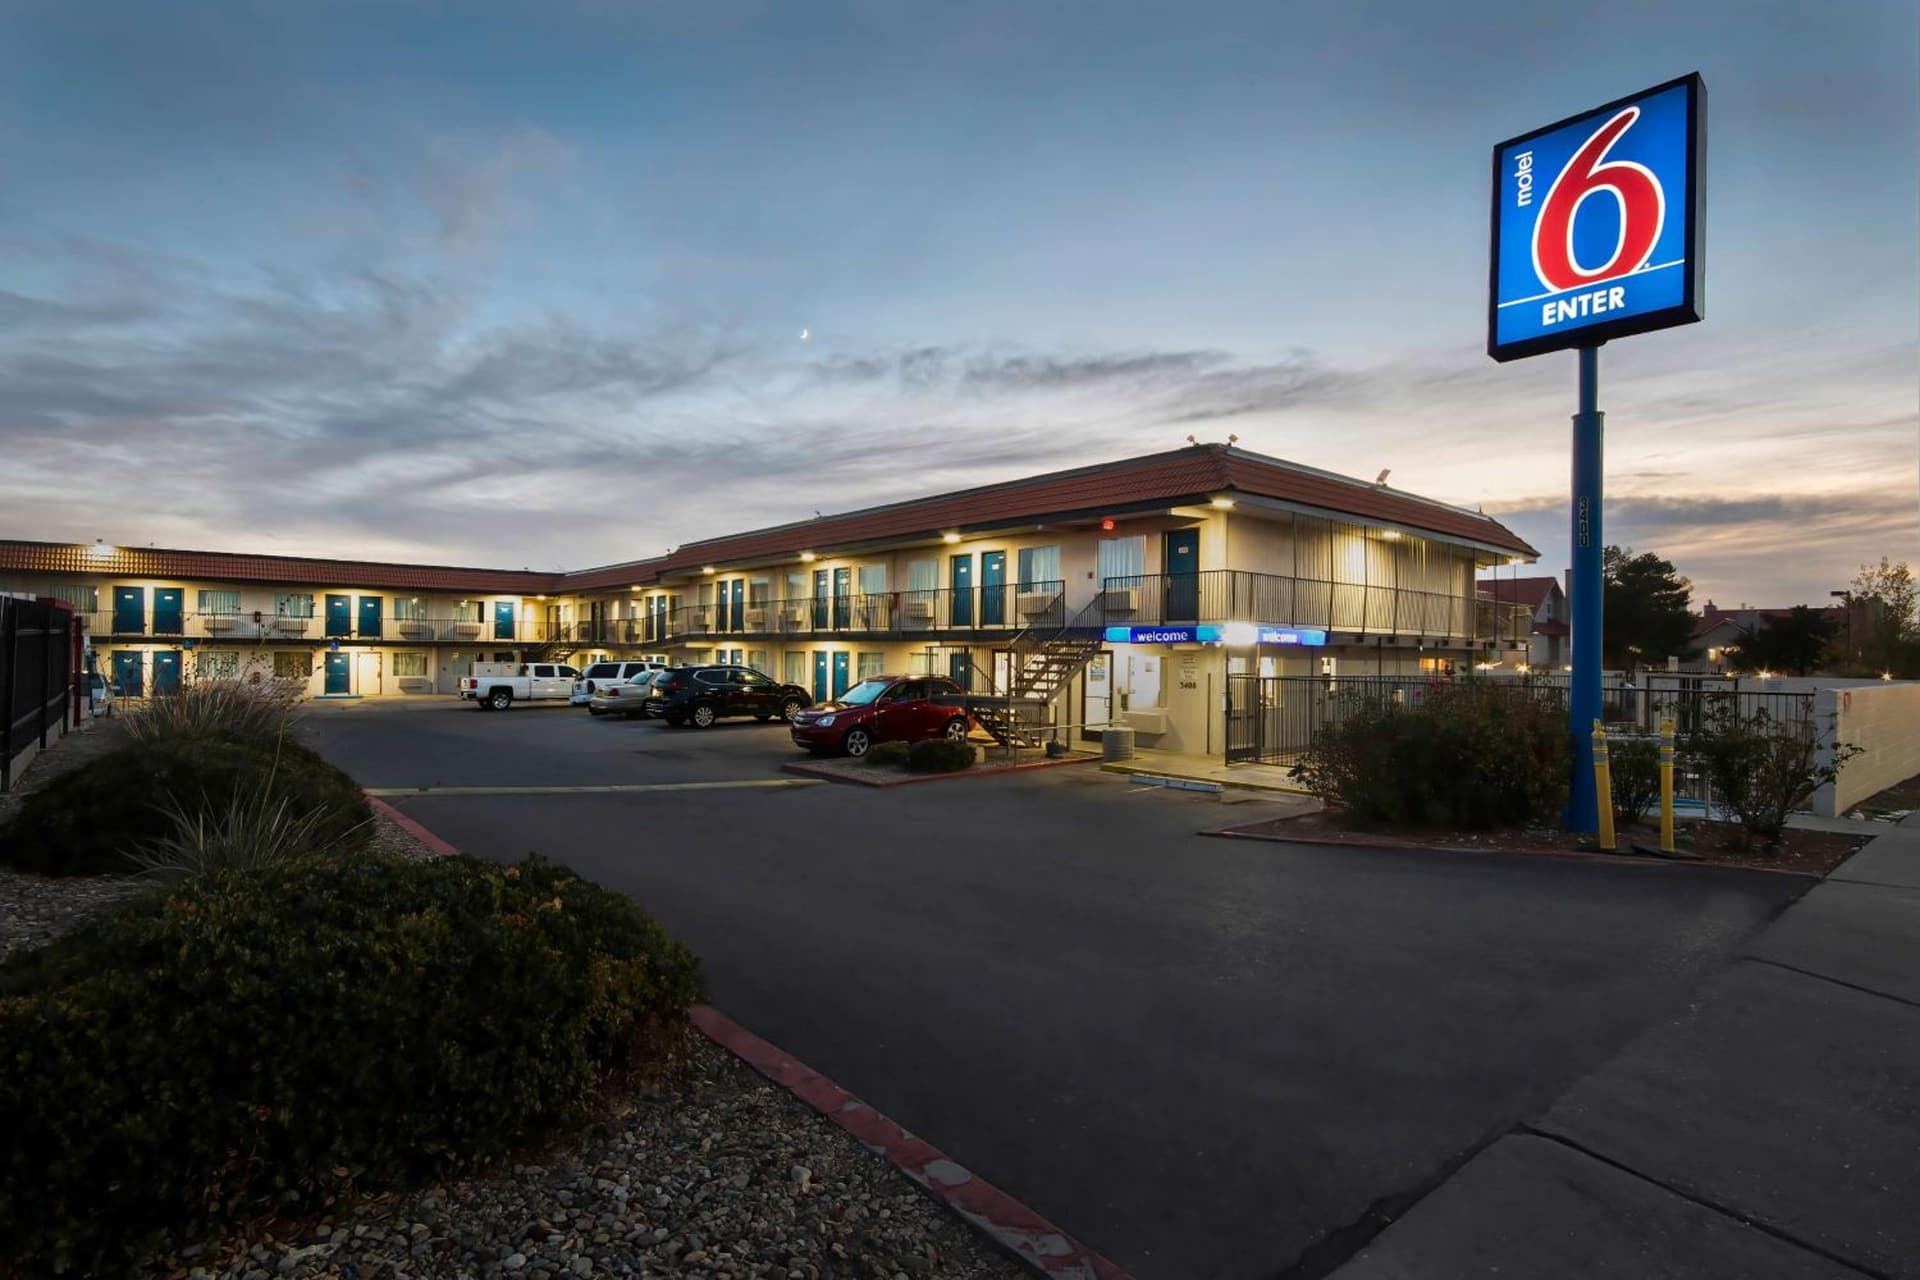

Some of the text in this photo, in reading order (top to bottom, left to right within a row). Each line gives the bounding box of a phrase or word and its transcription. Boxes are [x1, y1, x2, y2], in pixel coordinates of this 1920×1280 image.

[1515, 150, 1533, 207] motel
[1531, 106, 1666, 293] 6
[1541, 286, 1626, 327] ENTER
[1137, 631, 1189, 642] welcome
